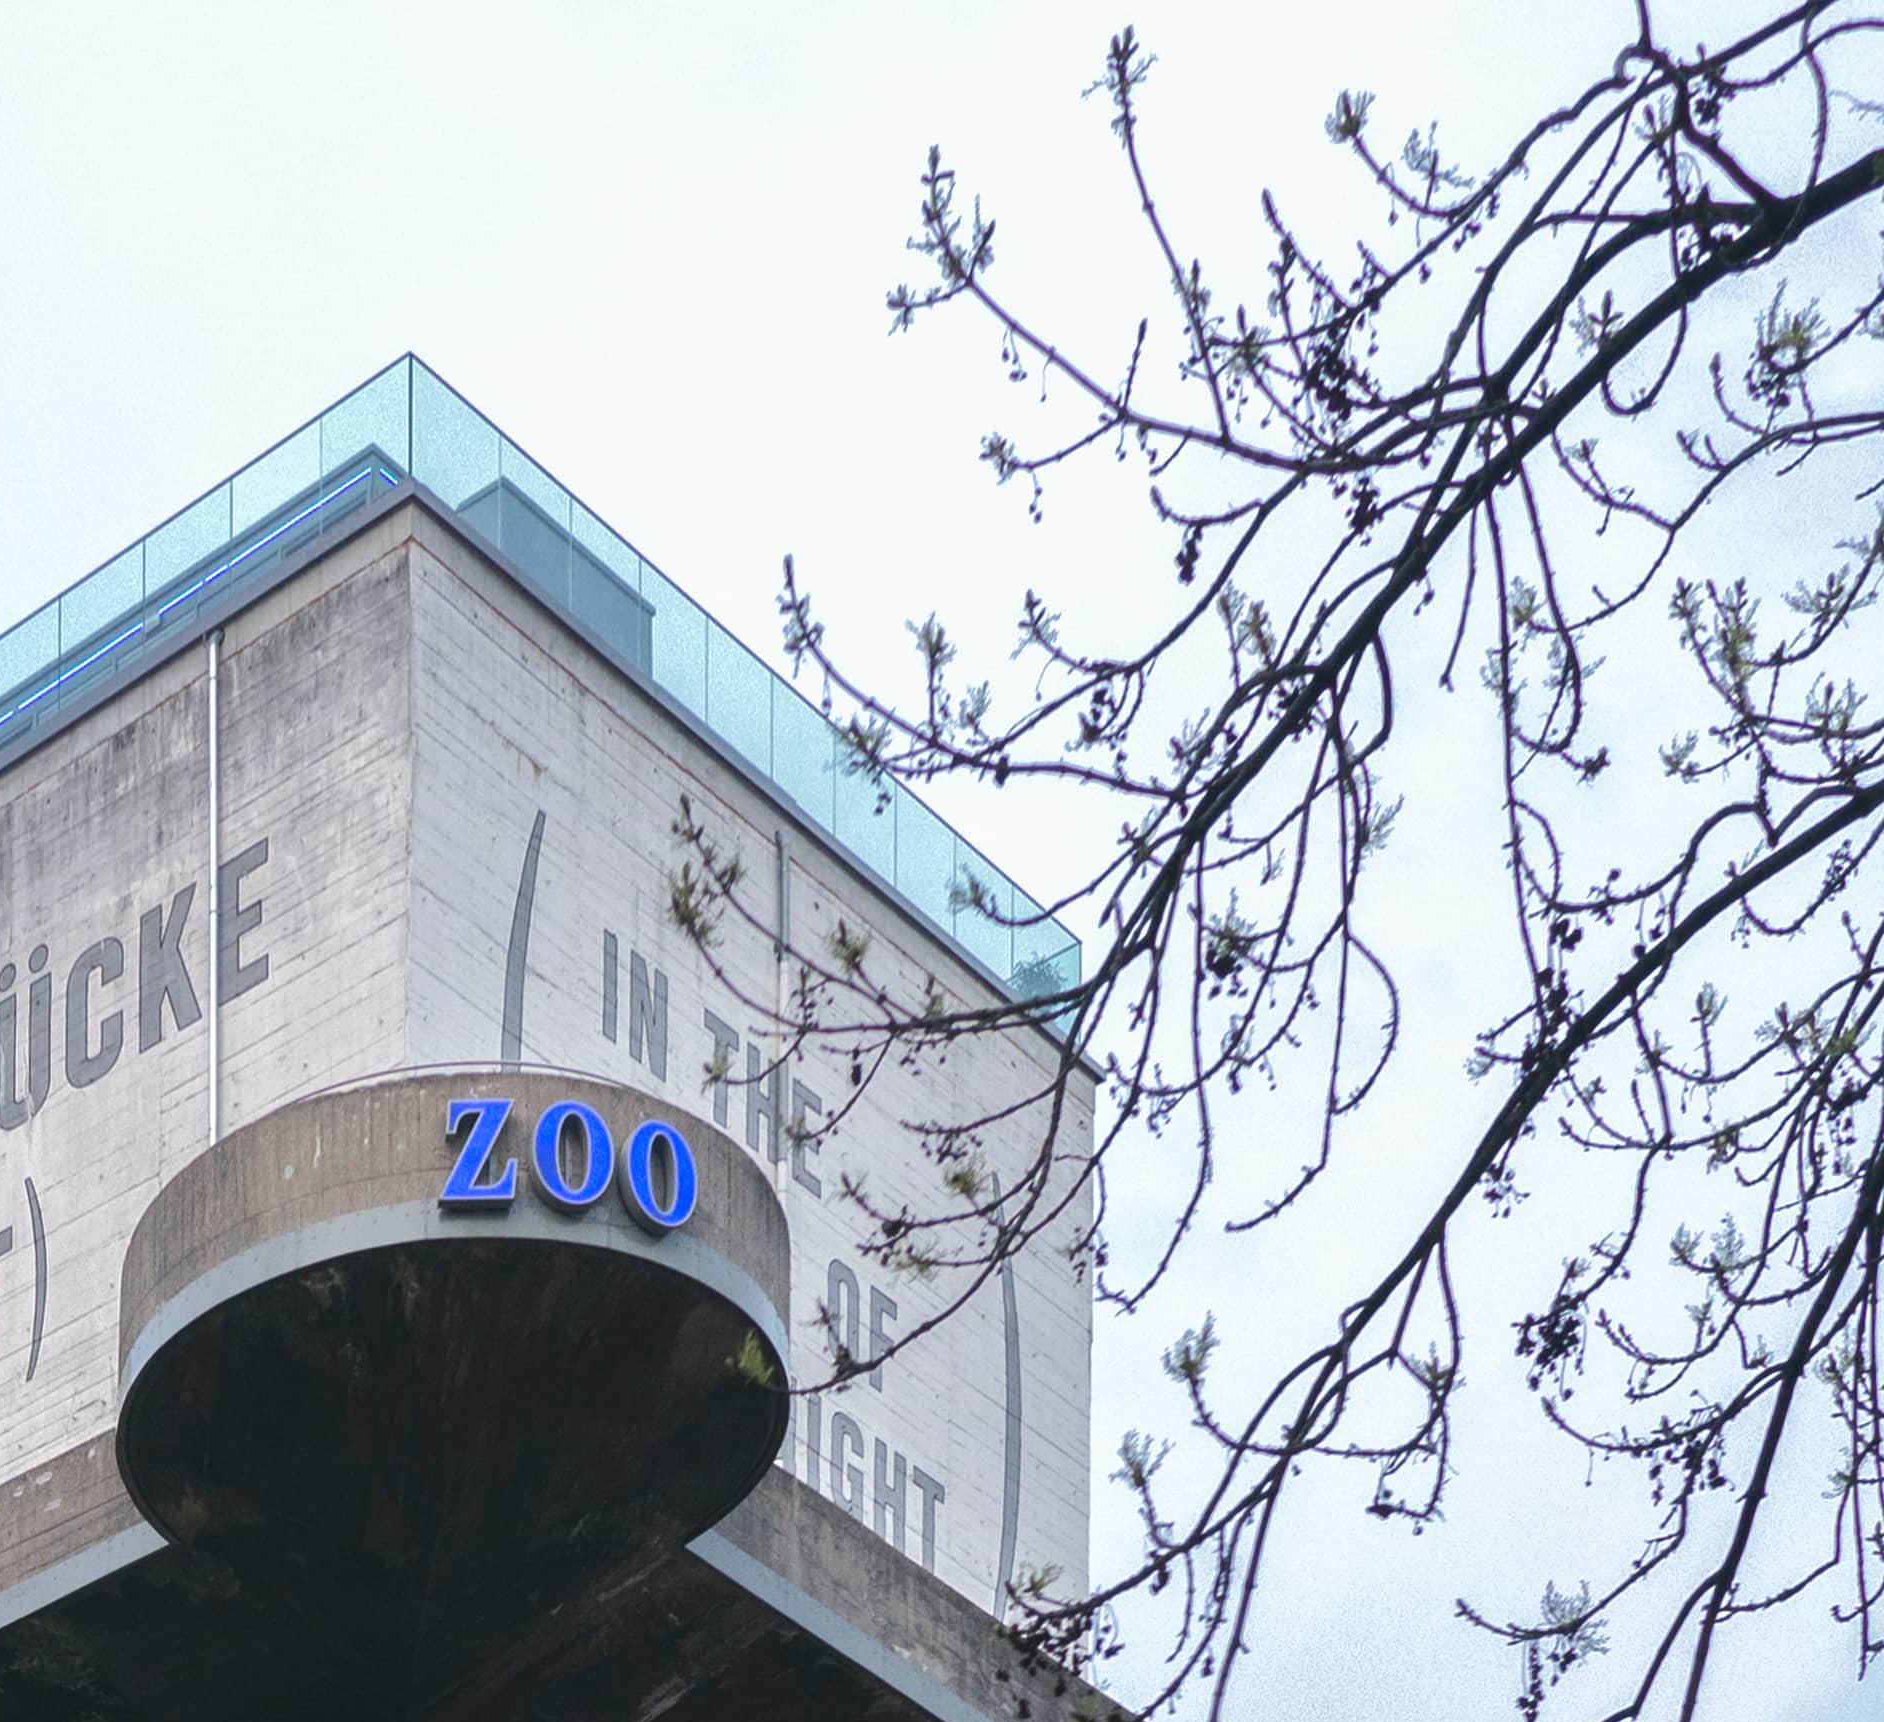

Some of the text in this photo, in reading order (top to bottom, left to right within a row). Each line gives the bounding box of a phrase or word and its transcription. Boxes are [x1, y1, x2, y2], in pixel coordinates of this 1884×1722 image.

[602, 927, 823, 1200] IN THE
[438, 1097, 700, 1232] ZOO
[827, 1258, 899, 1393] OF
[783, 1378, 946, 1577] IGHT
